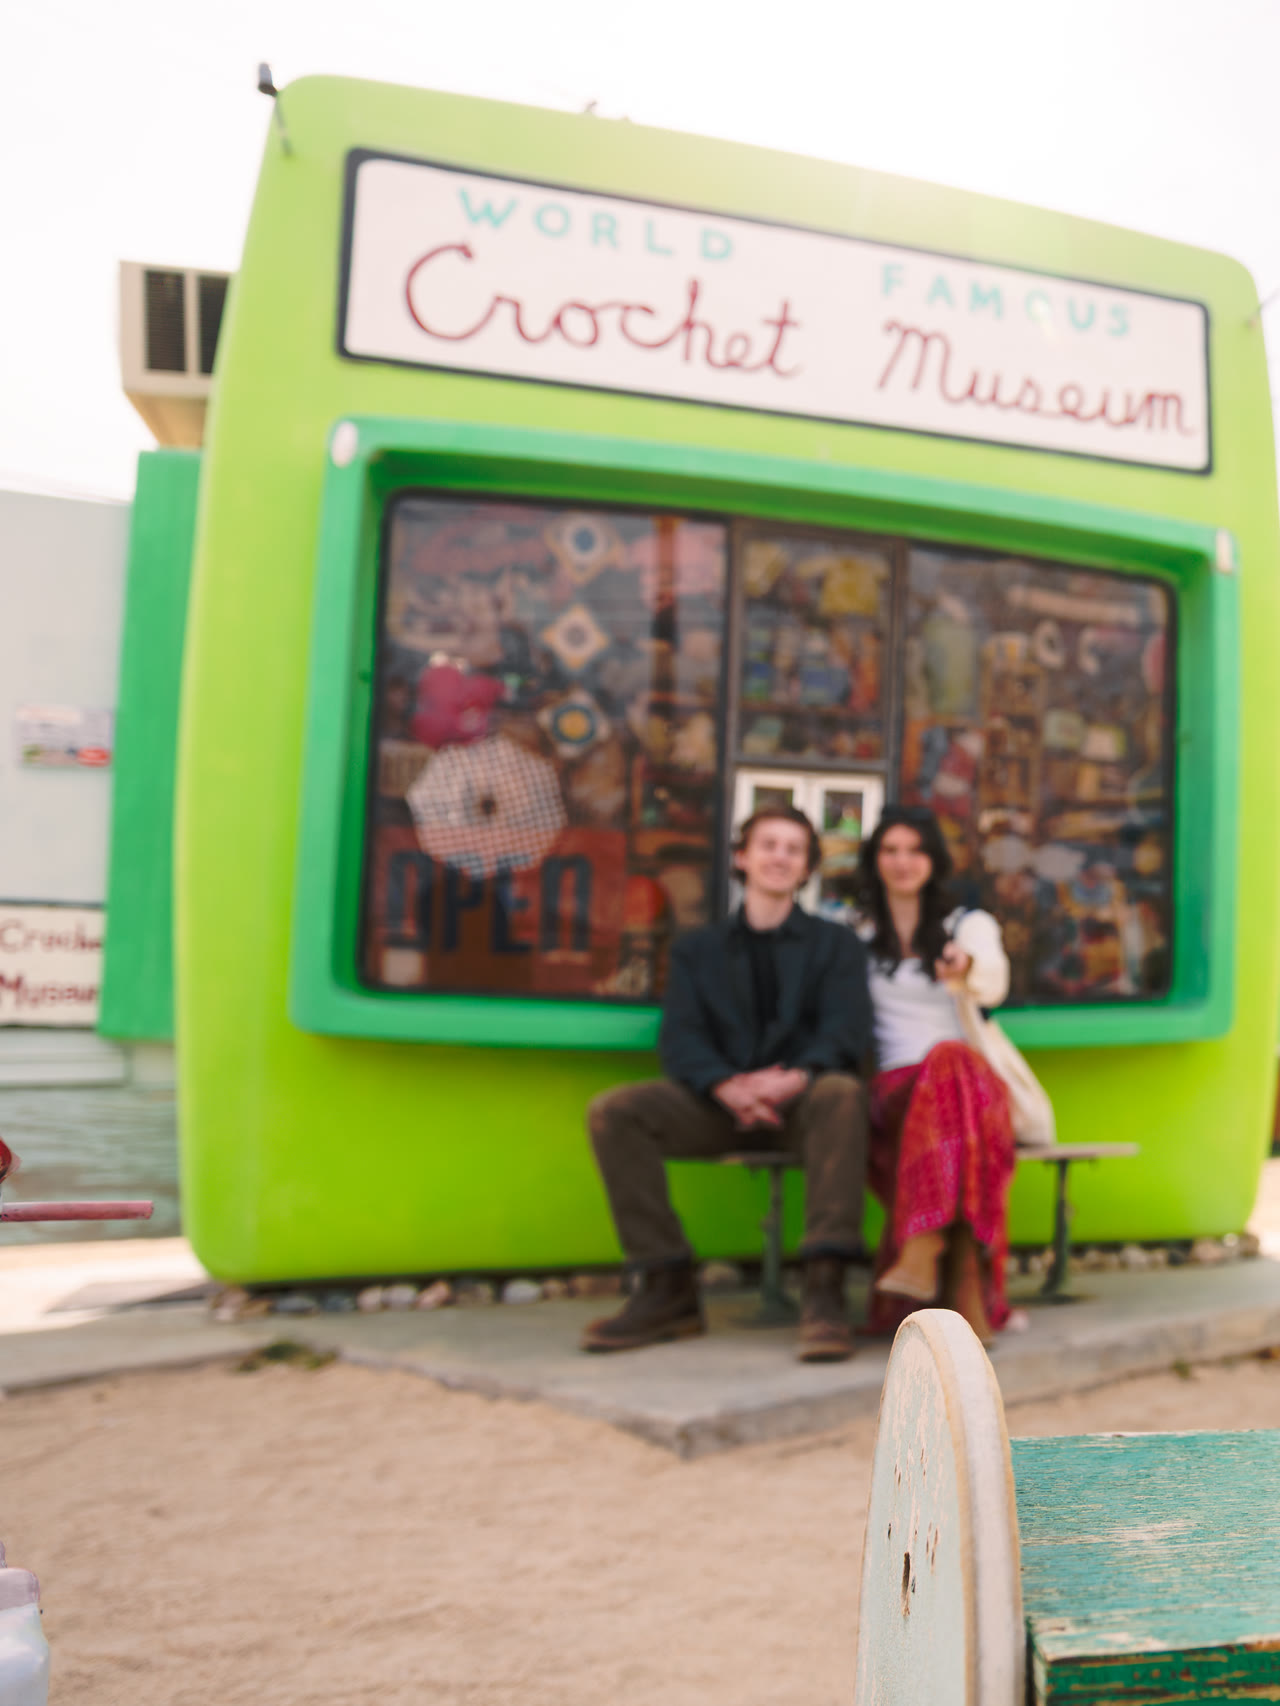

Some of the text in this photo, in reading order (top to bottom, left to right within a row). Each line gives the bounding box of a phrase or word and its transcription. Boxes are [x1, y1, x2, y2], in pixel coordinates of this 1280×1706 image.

[403, 242, 1198, 438] Crochet Museum
[458, 186, 1133, 338] WORLD FAMOUS
